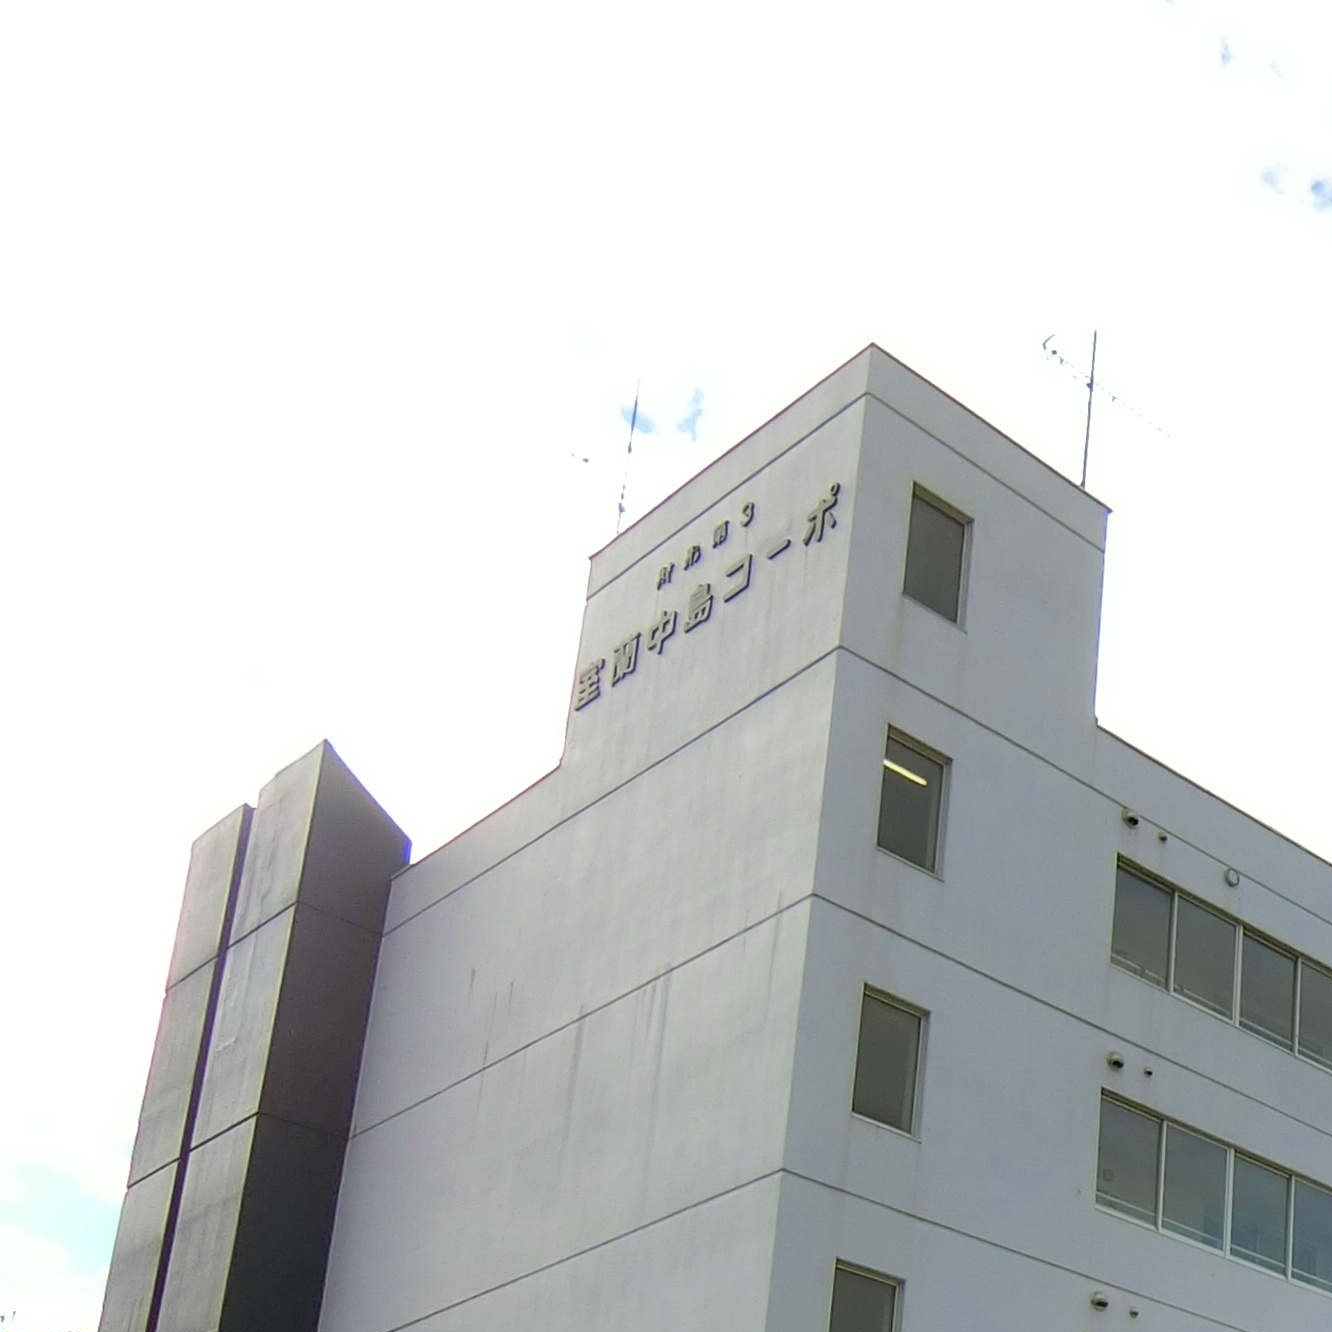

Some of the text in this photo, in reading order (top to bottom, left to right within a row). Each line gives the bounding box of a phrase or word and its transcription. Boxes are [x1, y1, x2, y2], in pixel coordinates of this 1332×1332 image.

[574, 482, 841, 711] 室蘭中島コーポ
